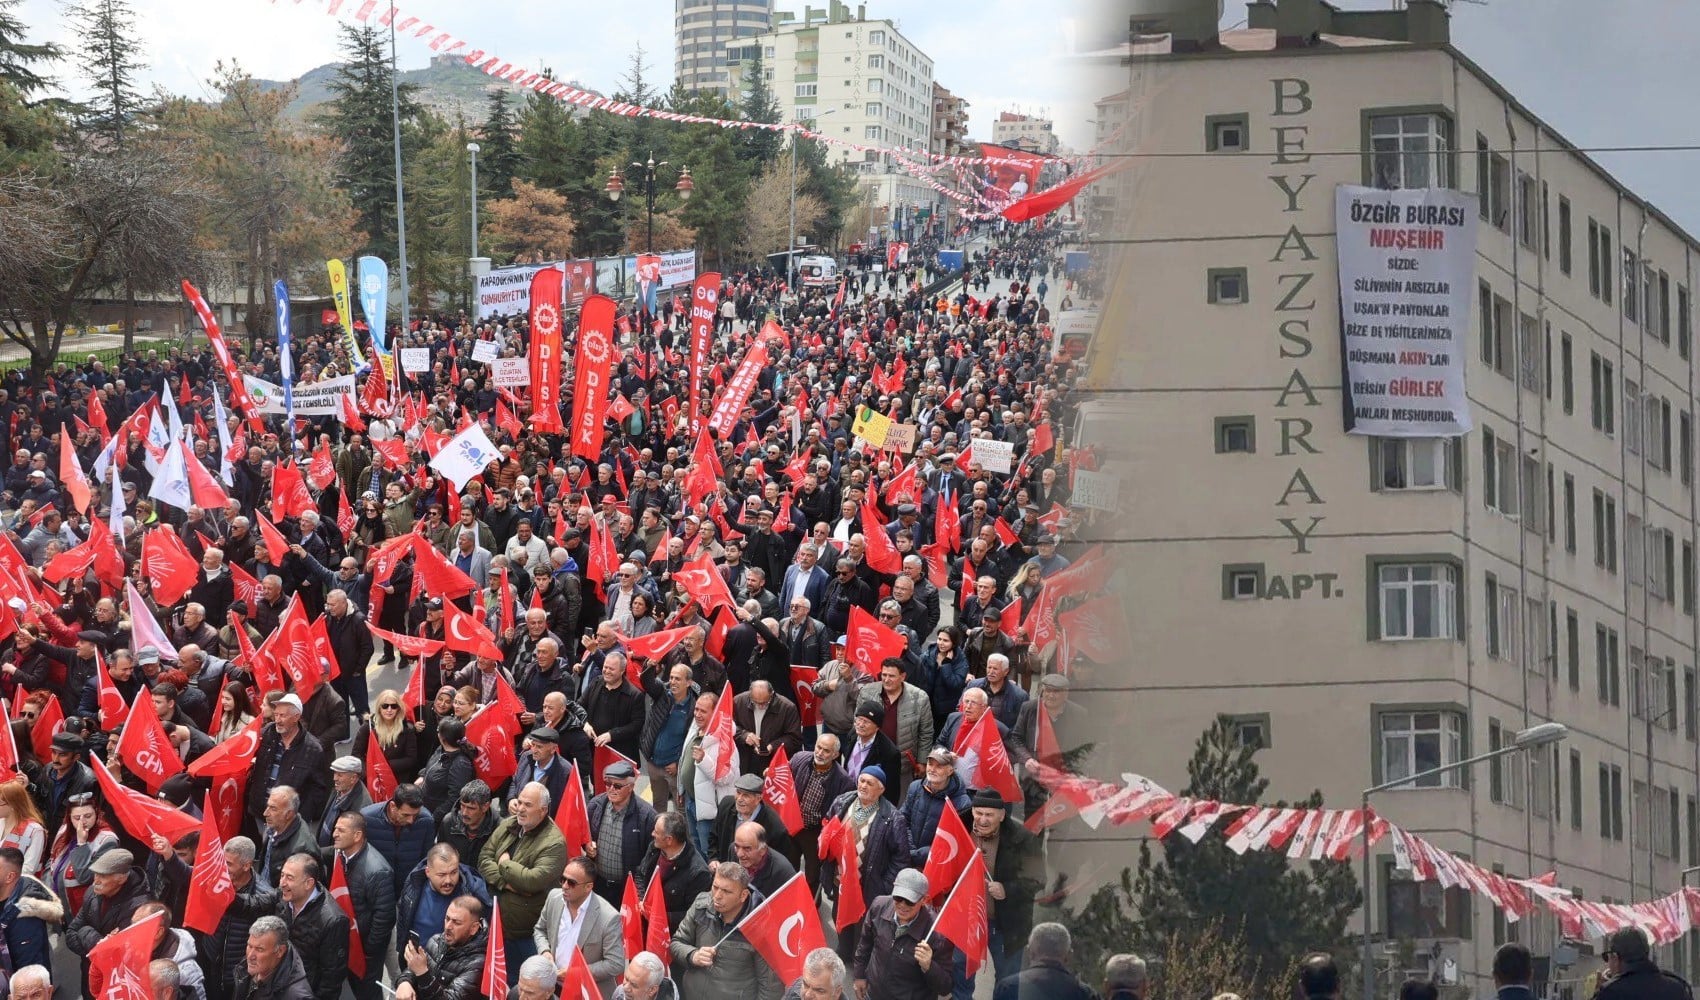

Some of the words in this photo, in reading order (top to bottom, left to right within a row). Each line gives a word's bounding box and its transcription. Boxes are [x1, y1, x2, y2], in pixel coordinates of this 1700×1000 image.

[1405, 204, 1465, 227] BURASI
[693, 306, 714, 322] DİSK
[1269, 78, 1326, 555] BEYAZSARAY
[1389, 376, 1444, 398] GÜRLEK
[581, 370, 599, 445] DİSK
[1264, 573, 1344, 600] APT.
[764, 777, 787, 806] CHP
